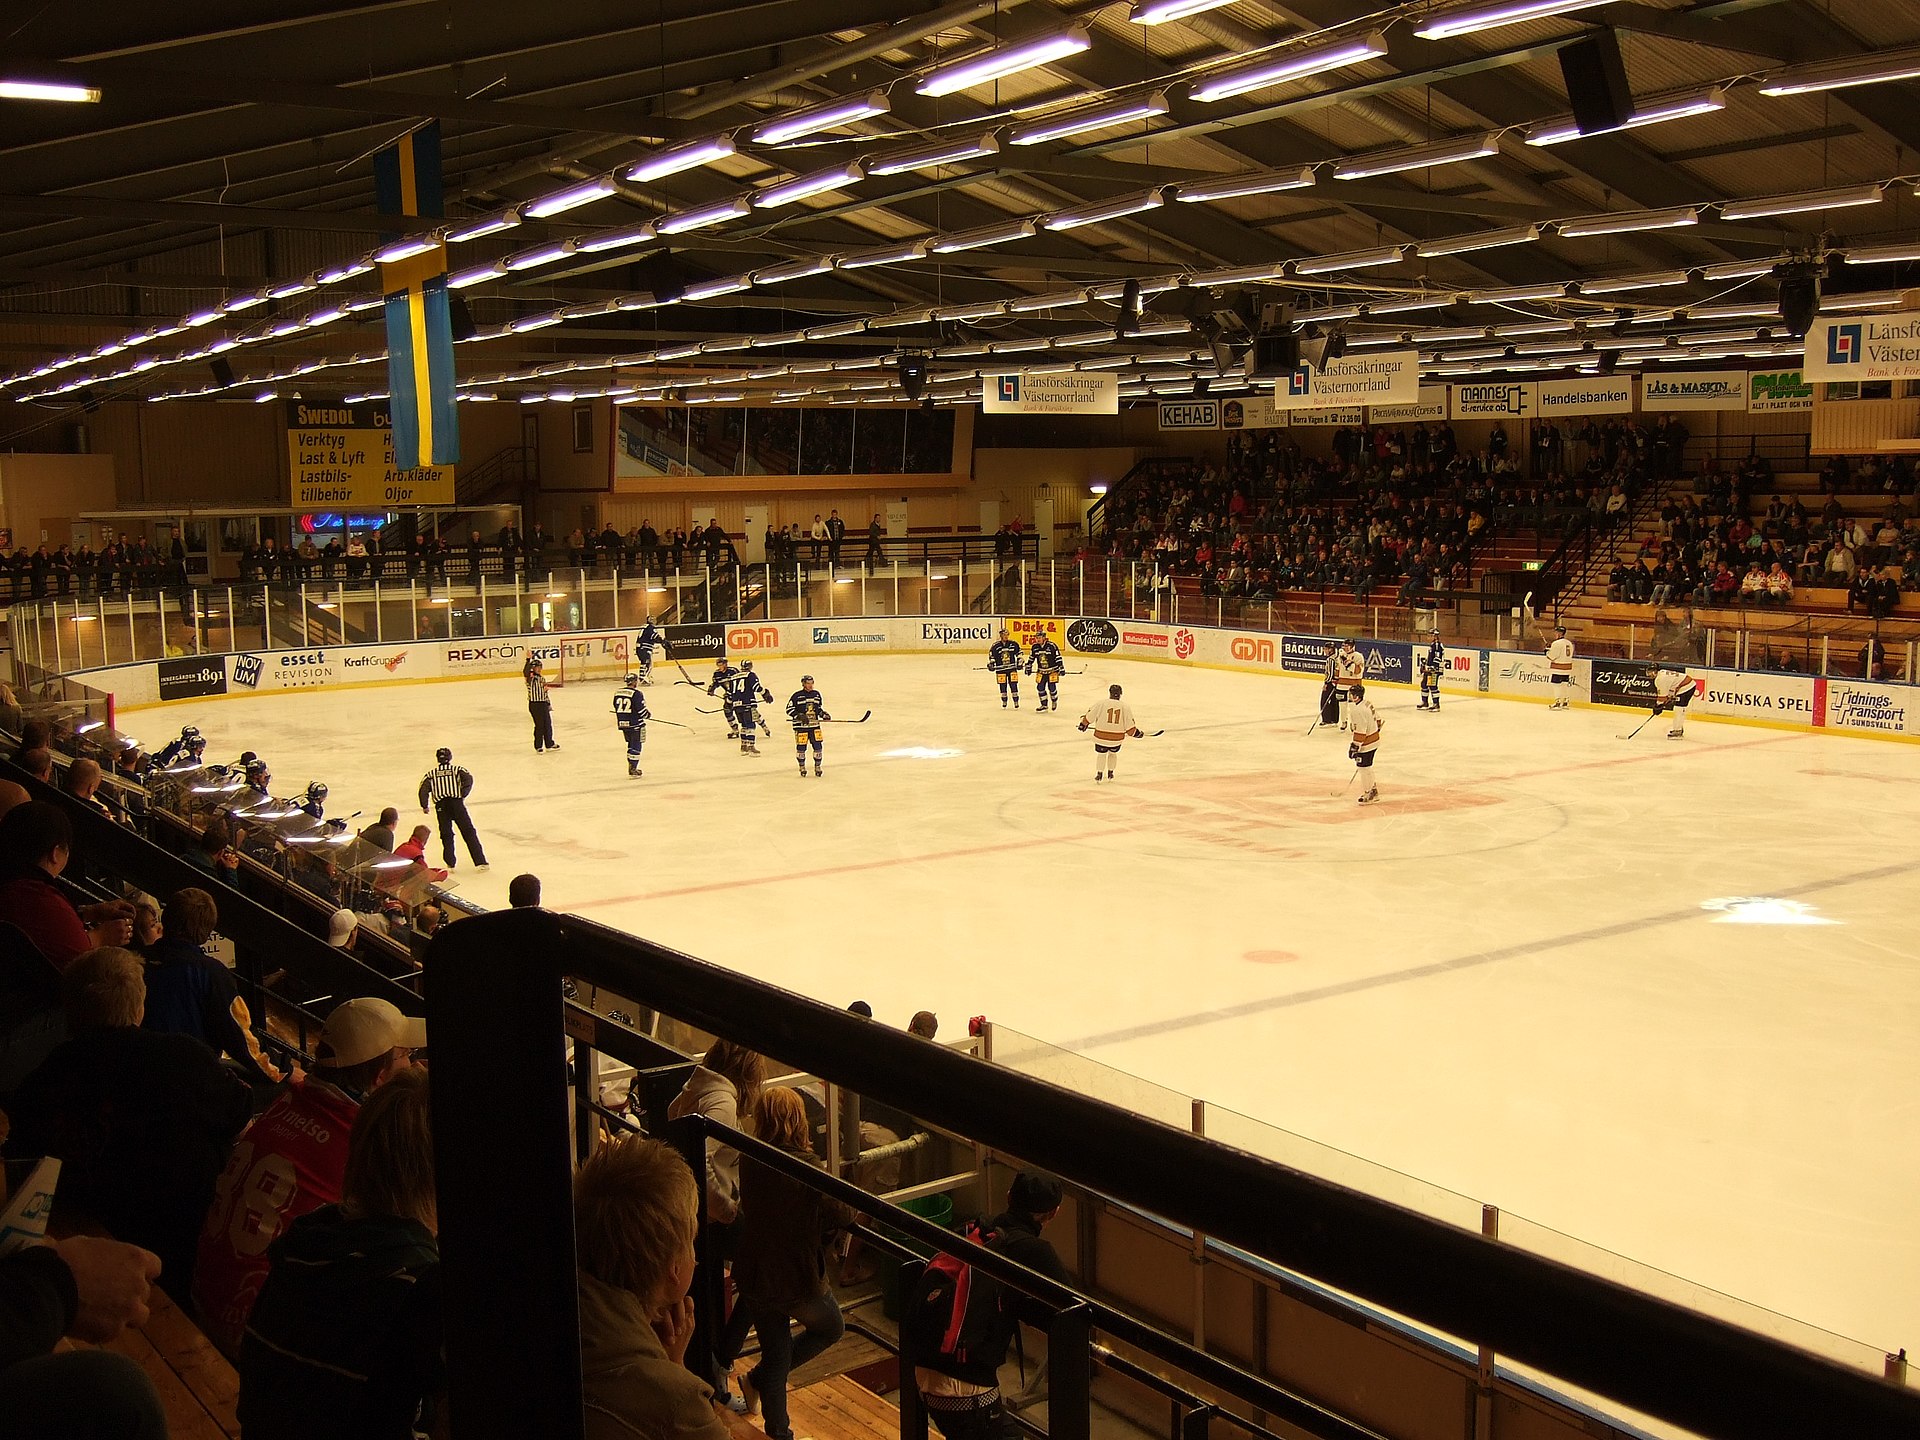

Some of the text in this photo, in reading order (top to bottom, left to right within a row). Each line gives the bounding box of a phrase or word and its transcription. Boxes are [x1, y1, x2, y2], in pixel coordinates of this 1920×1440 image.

[1867, 367, 1889, 378] Bank
[1892, 367, 1900, 376] &
[1023, 375, 1105, 391] Länsförsäkringar
[1313, 376, 1391, 395] Västernorrland
[1647, 379, 1728, 394] LÅS & MASKIN
[1023, 390, 1096, 403] Västernorrland
[1543, 390, 1628, 405] Handelsbanken
[1495, 402, 1506, 412] ab
[1770, 401, 1787, 409] PLAST
[298, 404, 355, 425] SWEDOL
[1163, 406, 1213, 425] KEHAB
[298, 433, 346, 448] Verktyg
[299, 451, 324, 465] Last
[329, 451, 338, 465] &
[341, 450, 366, 466] Lyft
[300, 468, 443, 483] Lastbils- Arb.kläder
[301, 487, 413, 502] tillbehör Oljor
[922, 623, 993, 645] Expancel
[1013, 621, 1057, 633] Däck &
[1081, 620, 1104, 636] Yrkes
[700, 634, 724, 650] 1891
[727, 627, 779, 650] GDM
[830, 634, 863, 644] SUNDSVALLS
[1073, 634, 1116, 649] Mästaren
[448, 643, 525, 662] REXrör
[1231, 637, 1274, 664] GDM
[1285, 641, 1343, 657] BÄCKLU
[281, 651, 325, 667] esset
[344, 655, 406, 668] KraftGruppen
[1385, 657, 1402, 669] SCA
[196, 667, 225, 686] 1891
[274, 668, 333, 680] REVISION
[1596, 671, 1651, 693] 25 höjdare
[732, 678, 745, 693] 14
[616, 697, 632, 714] 22
[1708, 690, 1812, 712] SVENSKA SPEL
[1107, 707, 1121, 725] 11
[1851, 719, 1893, 730] SUNDSVALL
[1894, 723, 1904, 731] AB
[282, 1108, 331, 1144] metso
